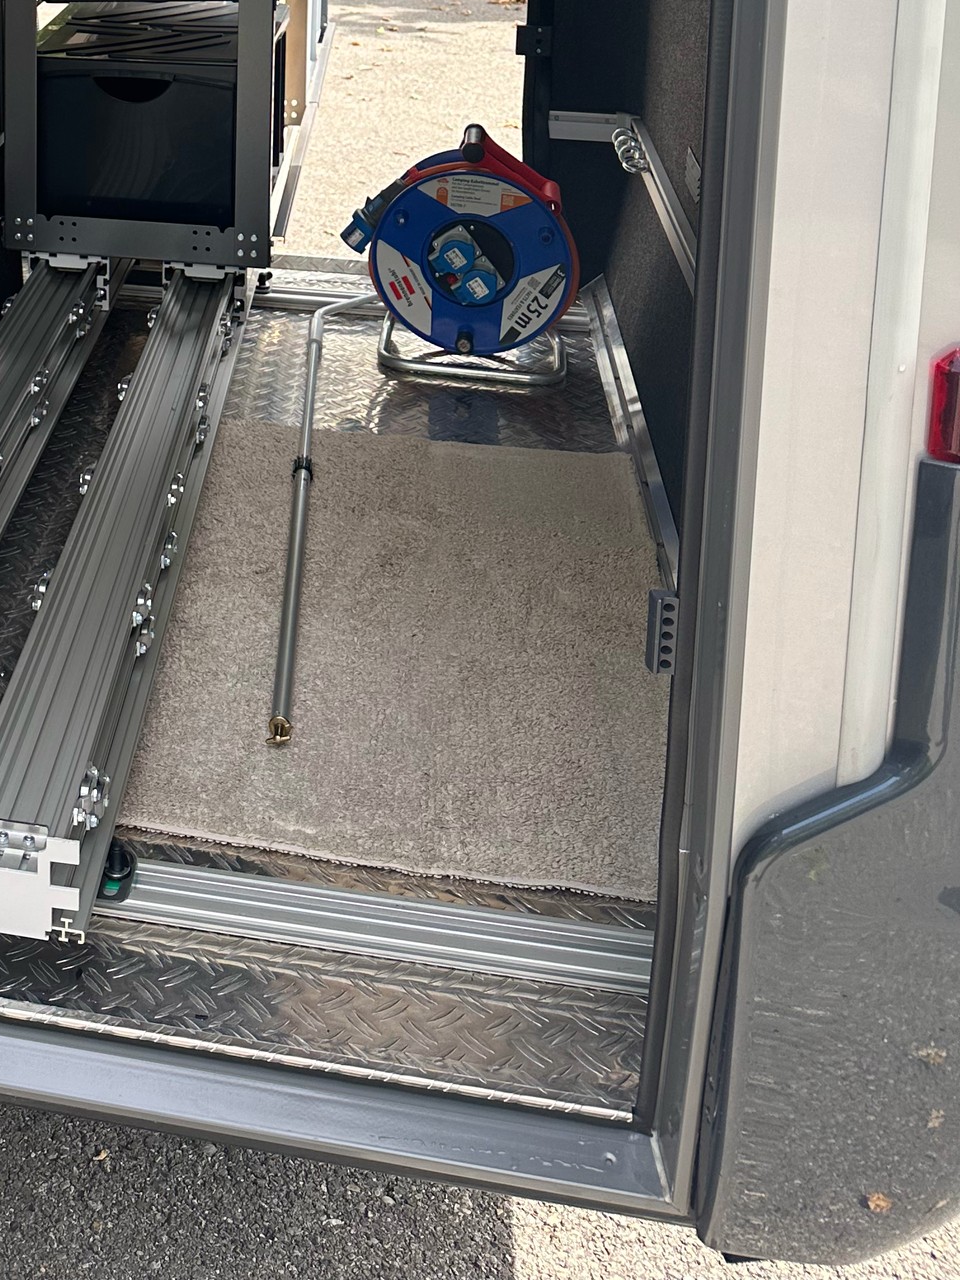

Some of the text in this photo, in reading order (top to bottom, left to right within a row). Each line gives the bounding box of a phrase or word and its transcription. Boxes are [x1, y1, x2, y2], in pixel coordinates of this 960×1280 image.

[522, 290, 533, 302] FACTS
[526, 295, 549, 318] 25
[515, 312, 532, 328] m
